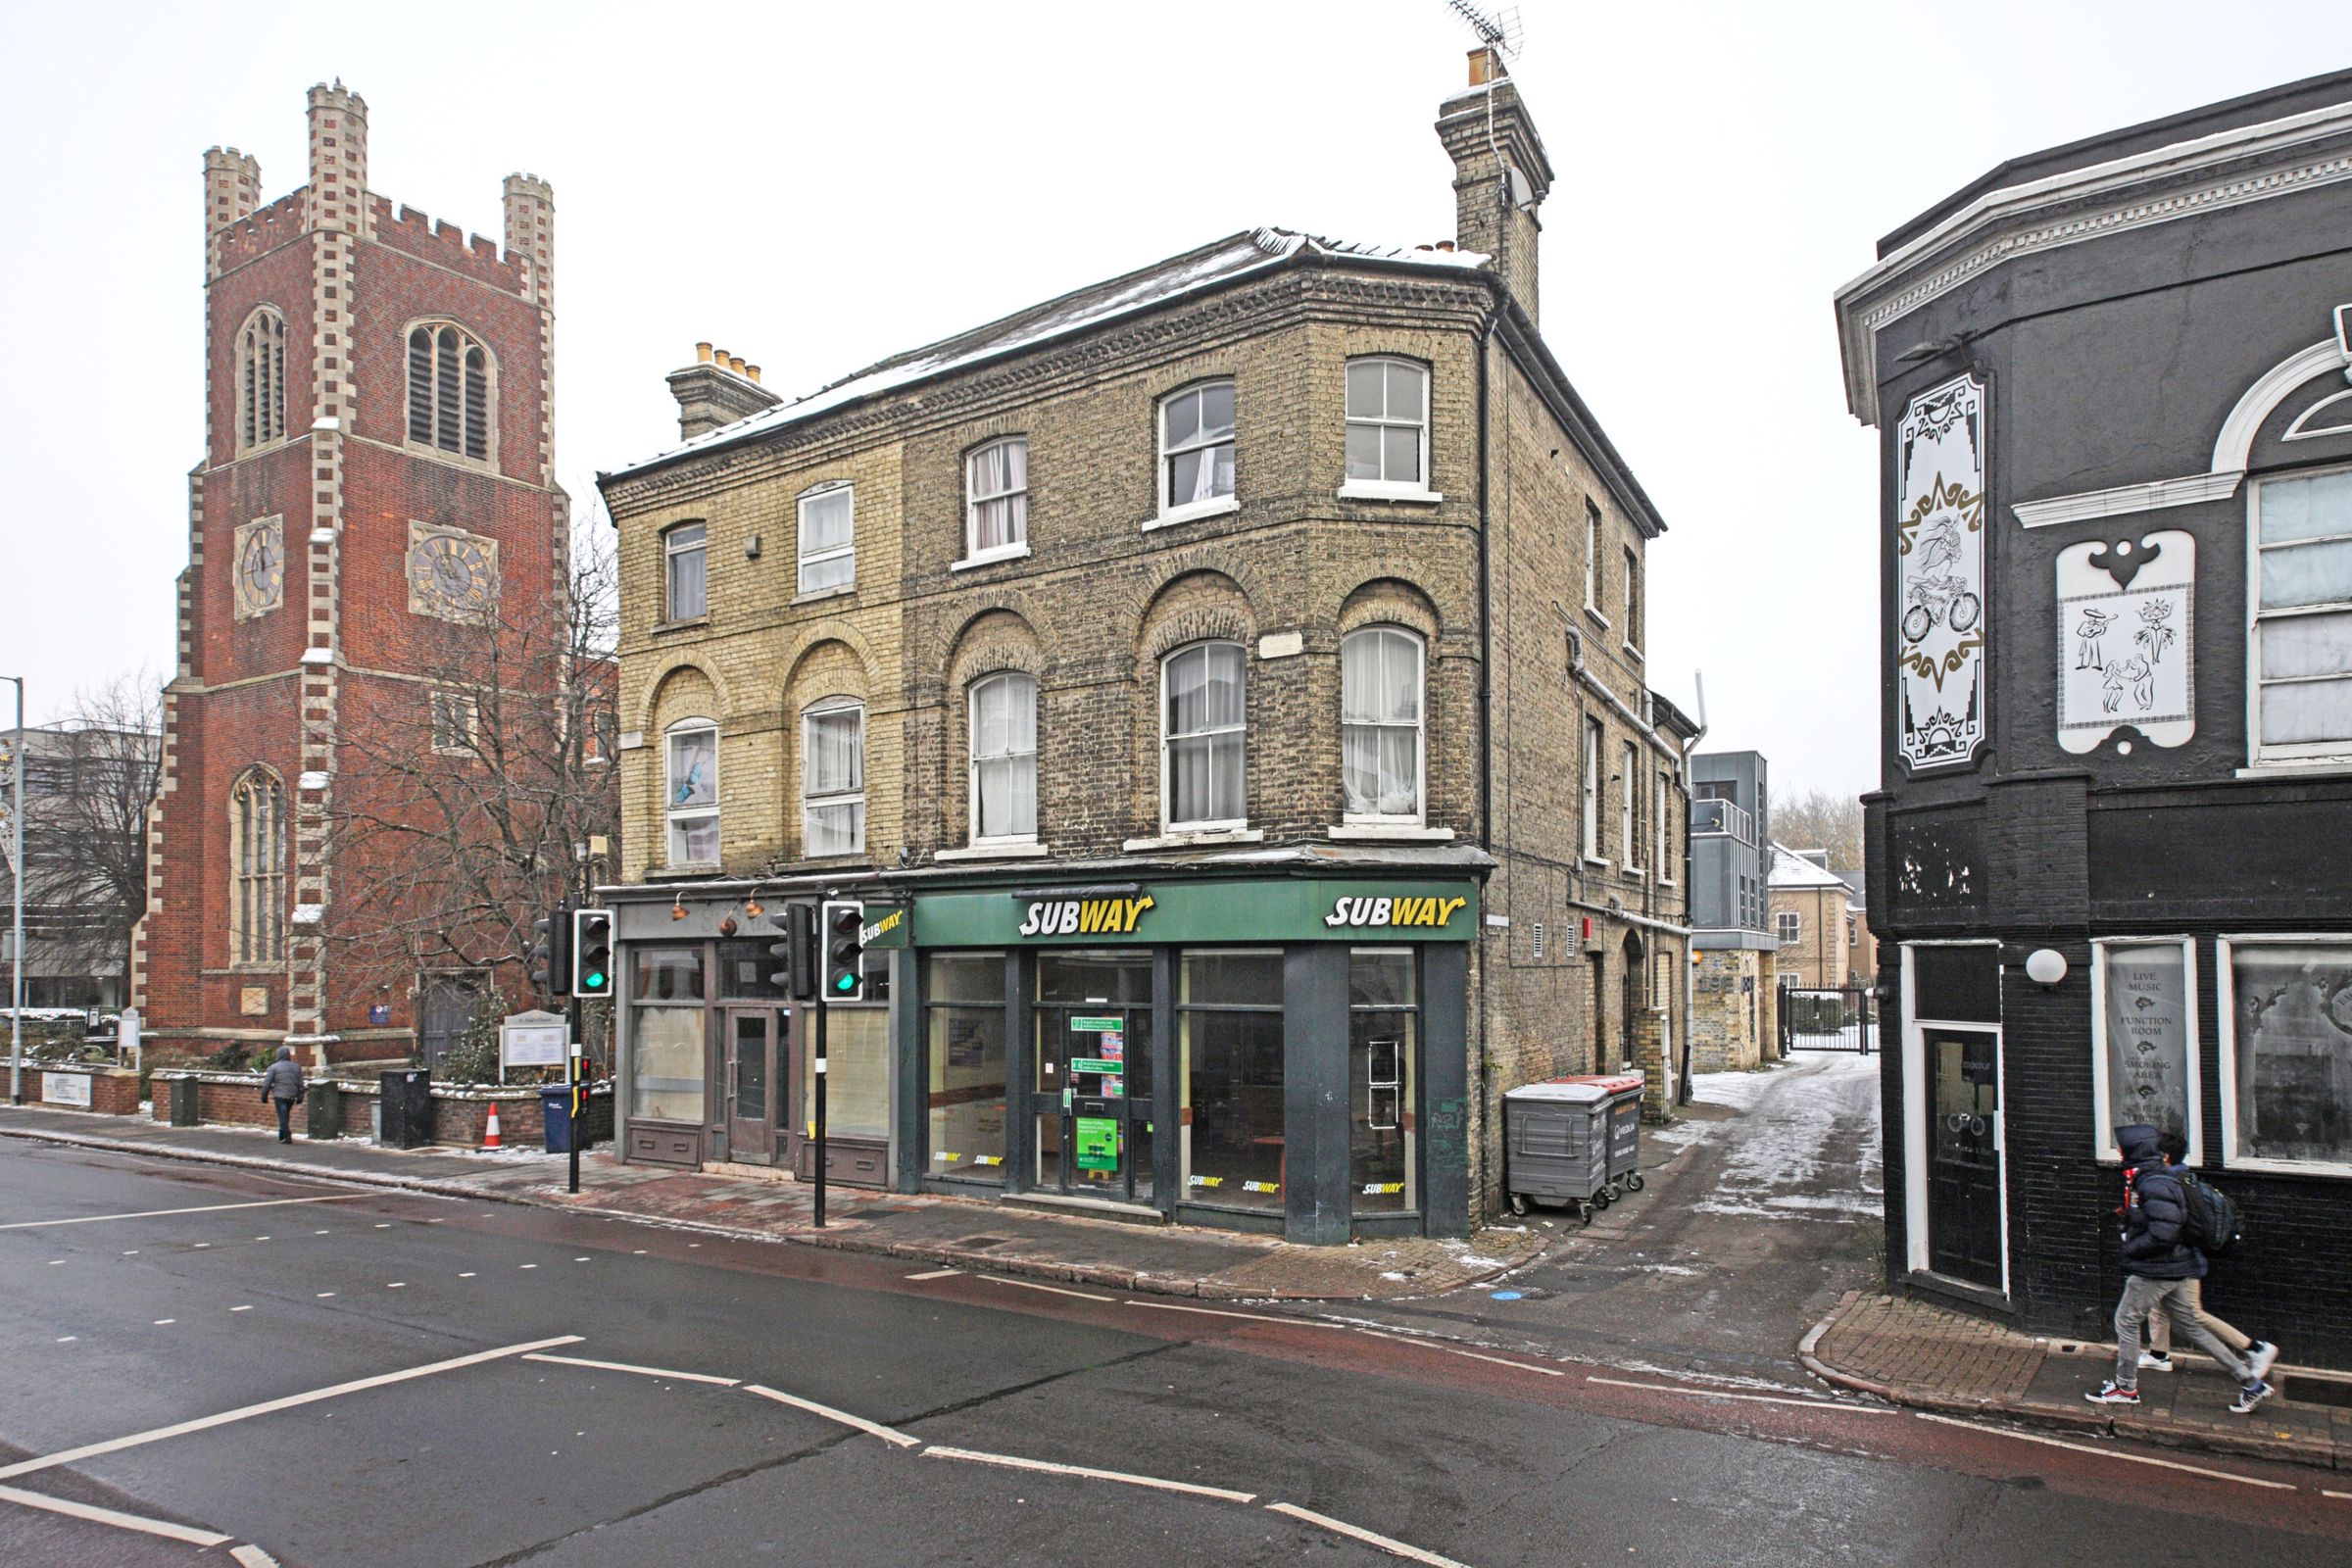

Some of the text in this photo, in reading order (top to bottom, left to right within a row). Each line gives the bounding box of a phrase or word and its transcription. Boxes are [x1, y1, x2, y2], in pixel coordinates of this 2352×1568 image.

[1019, 895, 1154, 936] SUBWAY
[1324, 896, 1467, 927] SUBWAY
[862, 909, 904, 945] SUBWAY
[2132, 972, 2157, 981] LIVE
[2129, 983, 2162, 992] MUSIC
[2125, 1060, 2171, 1069] SMOKING
[1187, 1175, 1223, 1188] SUBWAY
[1243, 1180, 1280, 1194] SUBWAY
[1362, 1182, 1405, 1195] SUBWAY
